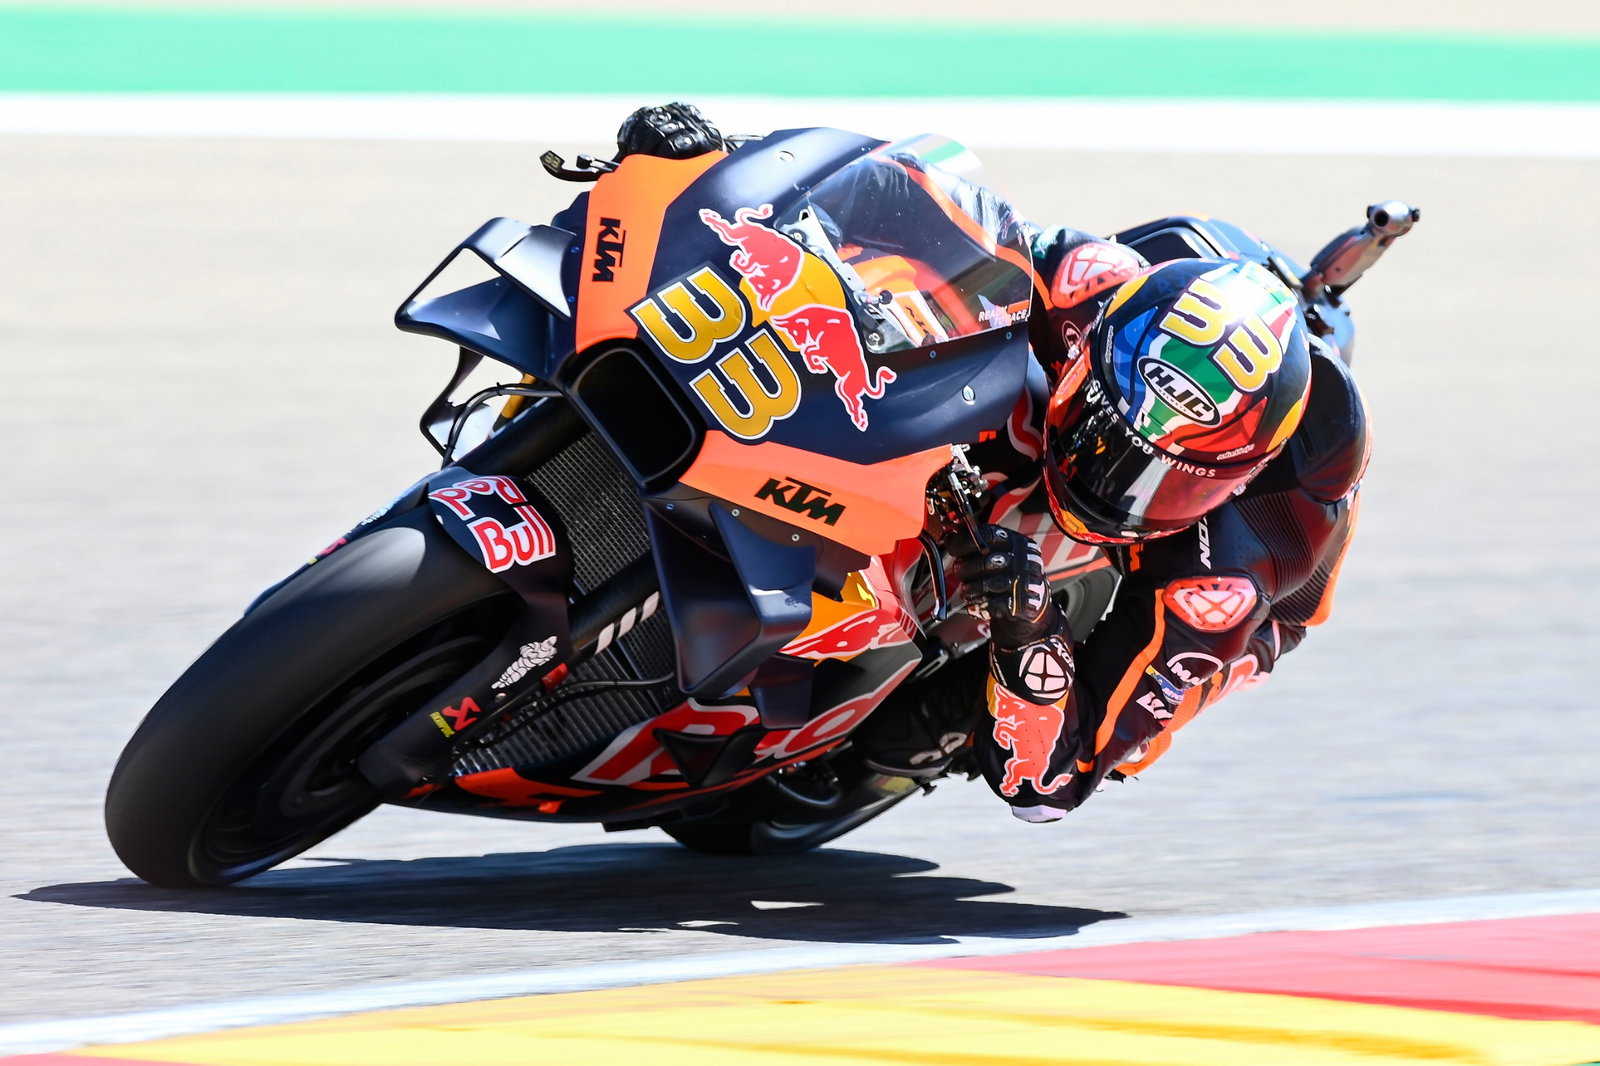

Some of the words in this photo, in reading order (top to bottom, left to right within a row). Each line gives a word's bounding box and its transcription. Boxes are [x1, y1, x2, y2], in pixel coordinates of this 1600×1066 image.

[592, 217, 626, 282] KTM
[630, 266, 801, 439] 33
[1159, 280, 1284, 392] 33
[1145, 365, 1213, 418] HJC
[1125, 426, 1154, 455] YOU
[1161, 454, 1216, 477] WINGS
[428, 475, 528, 521] Red
[754, 476, 846, 527] KTM
[466, 504, 556, 573] Bull
